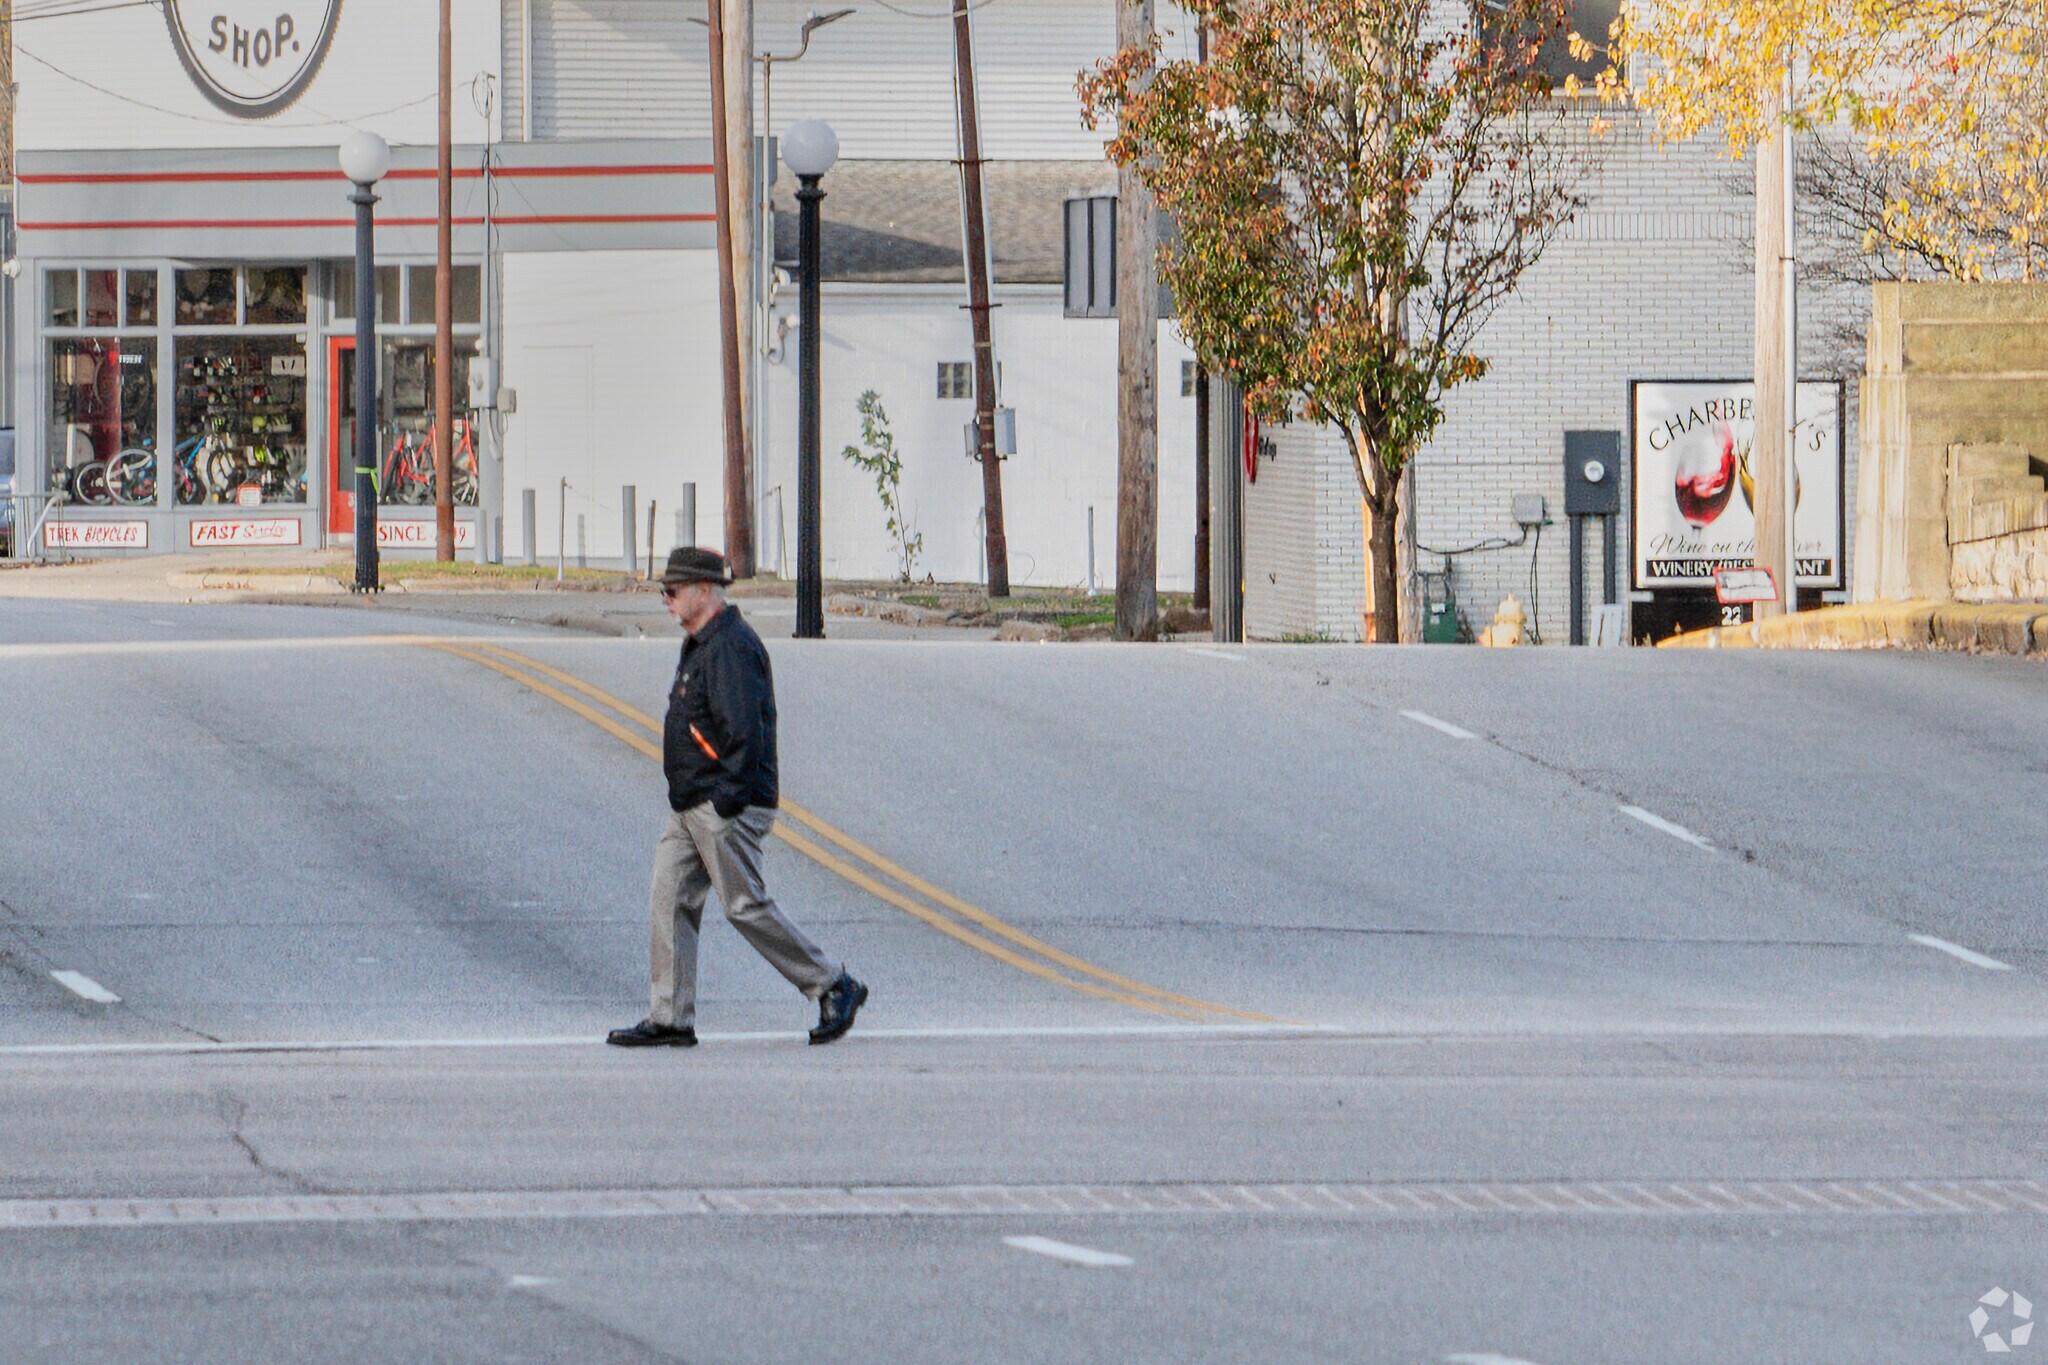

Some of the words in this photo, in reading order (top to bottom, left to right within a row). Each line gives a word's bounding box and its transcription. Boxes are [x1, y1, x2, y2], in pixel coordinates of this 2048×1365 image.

[208, 13, 299, 68] SHOP.
[49, 527, 79, 542] TREK
[85, 526, 138, 542] BICYCLES
[197, 525, 240, 540] FAST
[379, 525, 426, 542] SINCE
[1650, 533, 1706, 555] Wine
